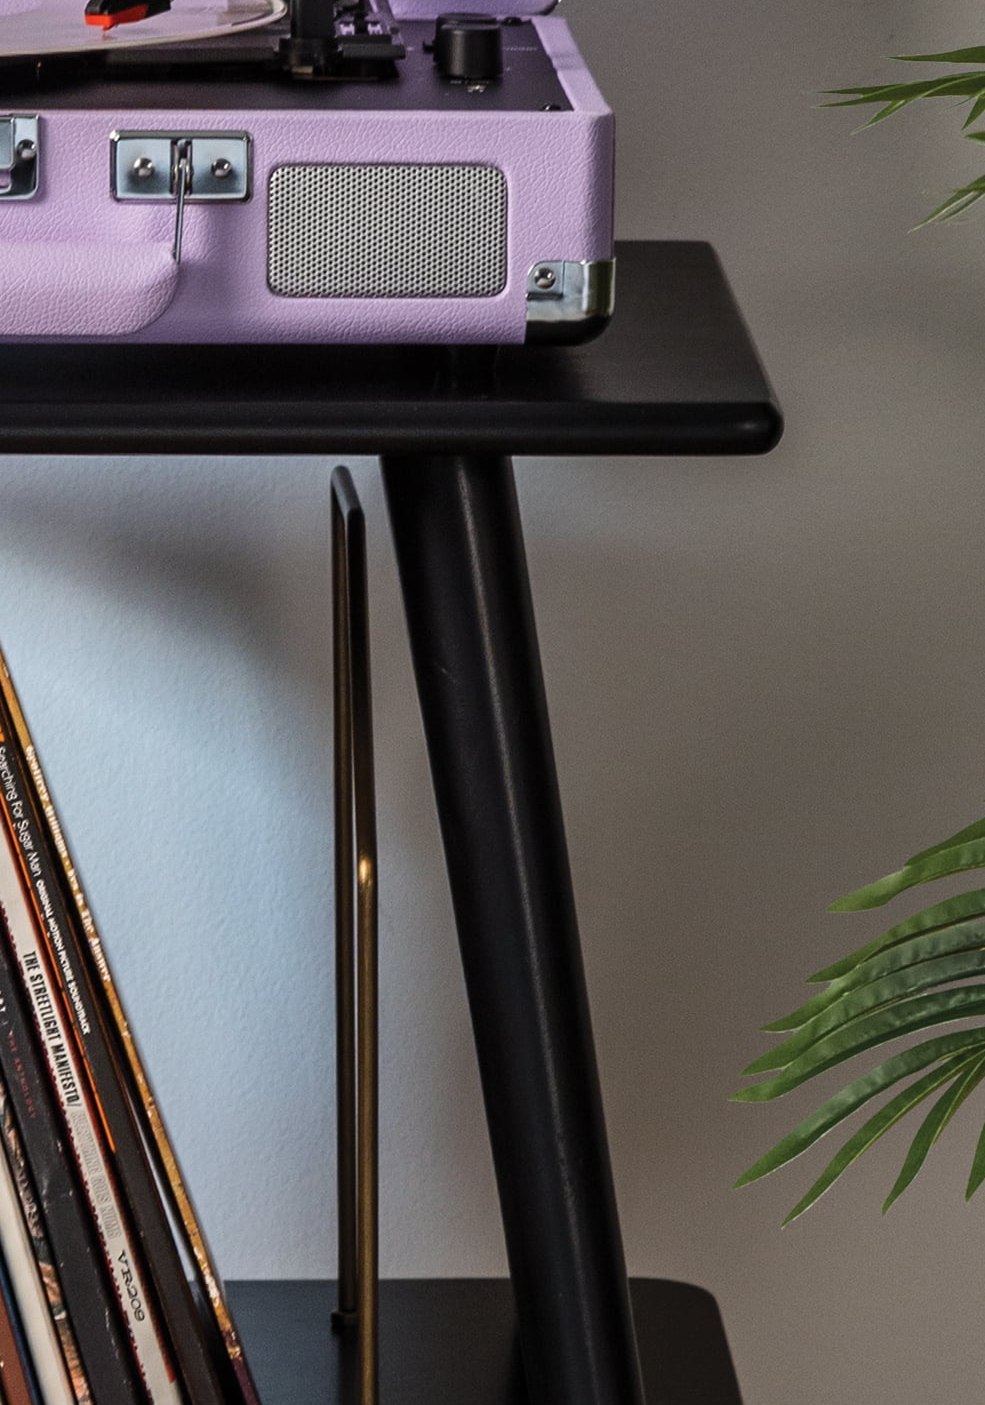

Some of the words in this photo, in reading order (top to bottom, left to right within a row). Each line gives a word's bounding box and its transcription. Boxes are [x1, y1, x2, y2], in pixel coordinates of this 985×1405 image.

[11, 800, 24, 819] For
[15, 819, 34, 852] Sugar
[27, 851, 42, 877] Man
[23, 950, 40, 972] THE
[36, 879, 54, 918] ORIGINAL
[47, 917, 64, 951] MOTION
[58, 950, 74, 982] PICTURE
[67, 981, 91, 1035] SOUNDTRACK
[29, 973, 62, 1041] STREETLIGHT
[117, 1249, 146, 1322] VR209
